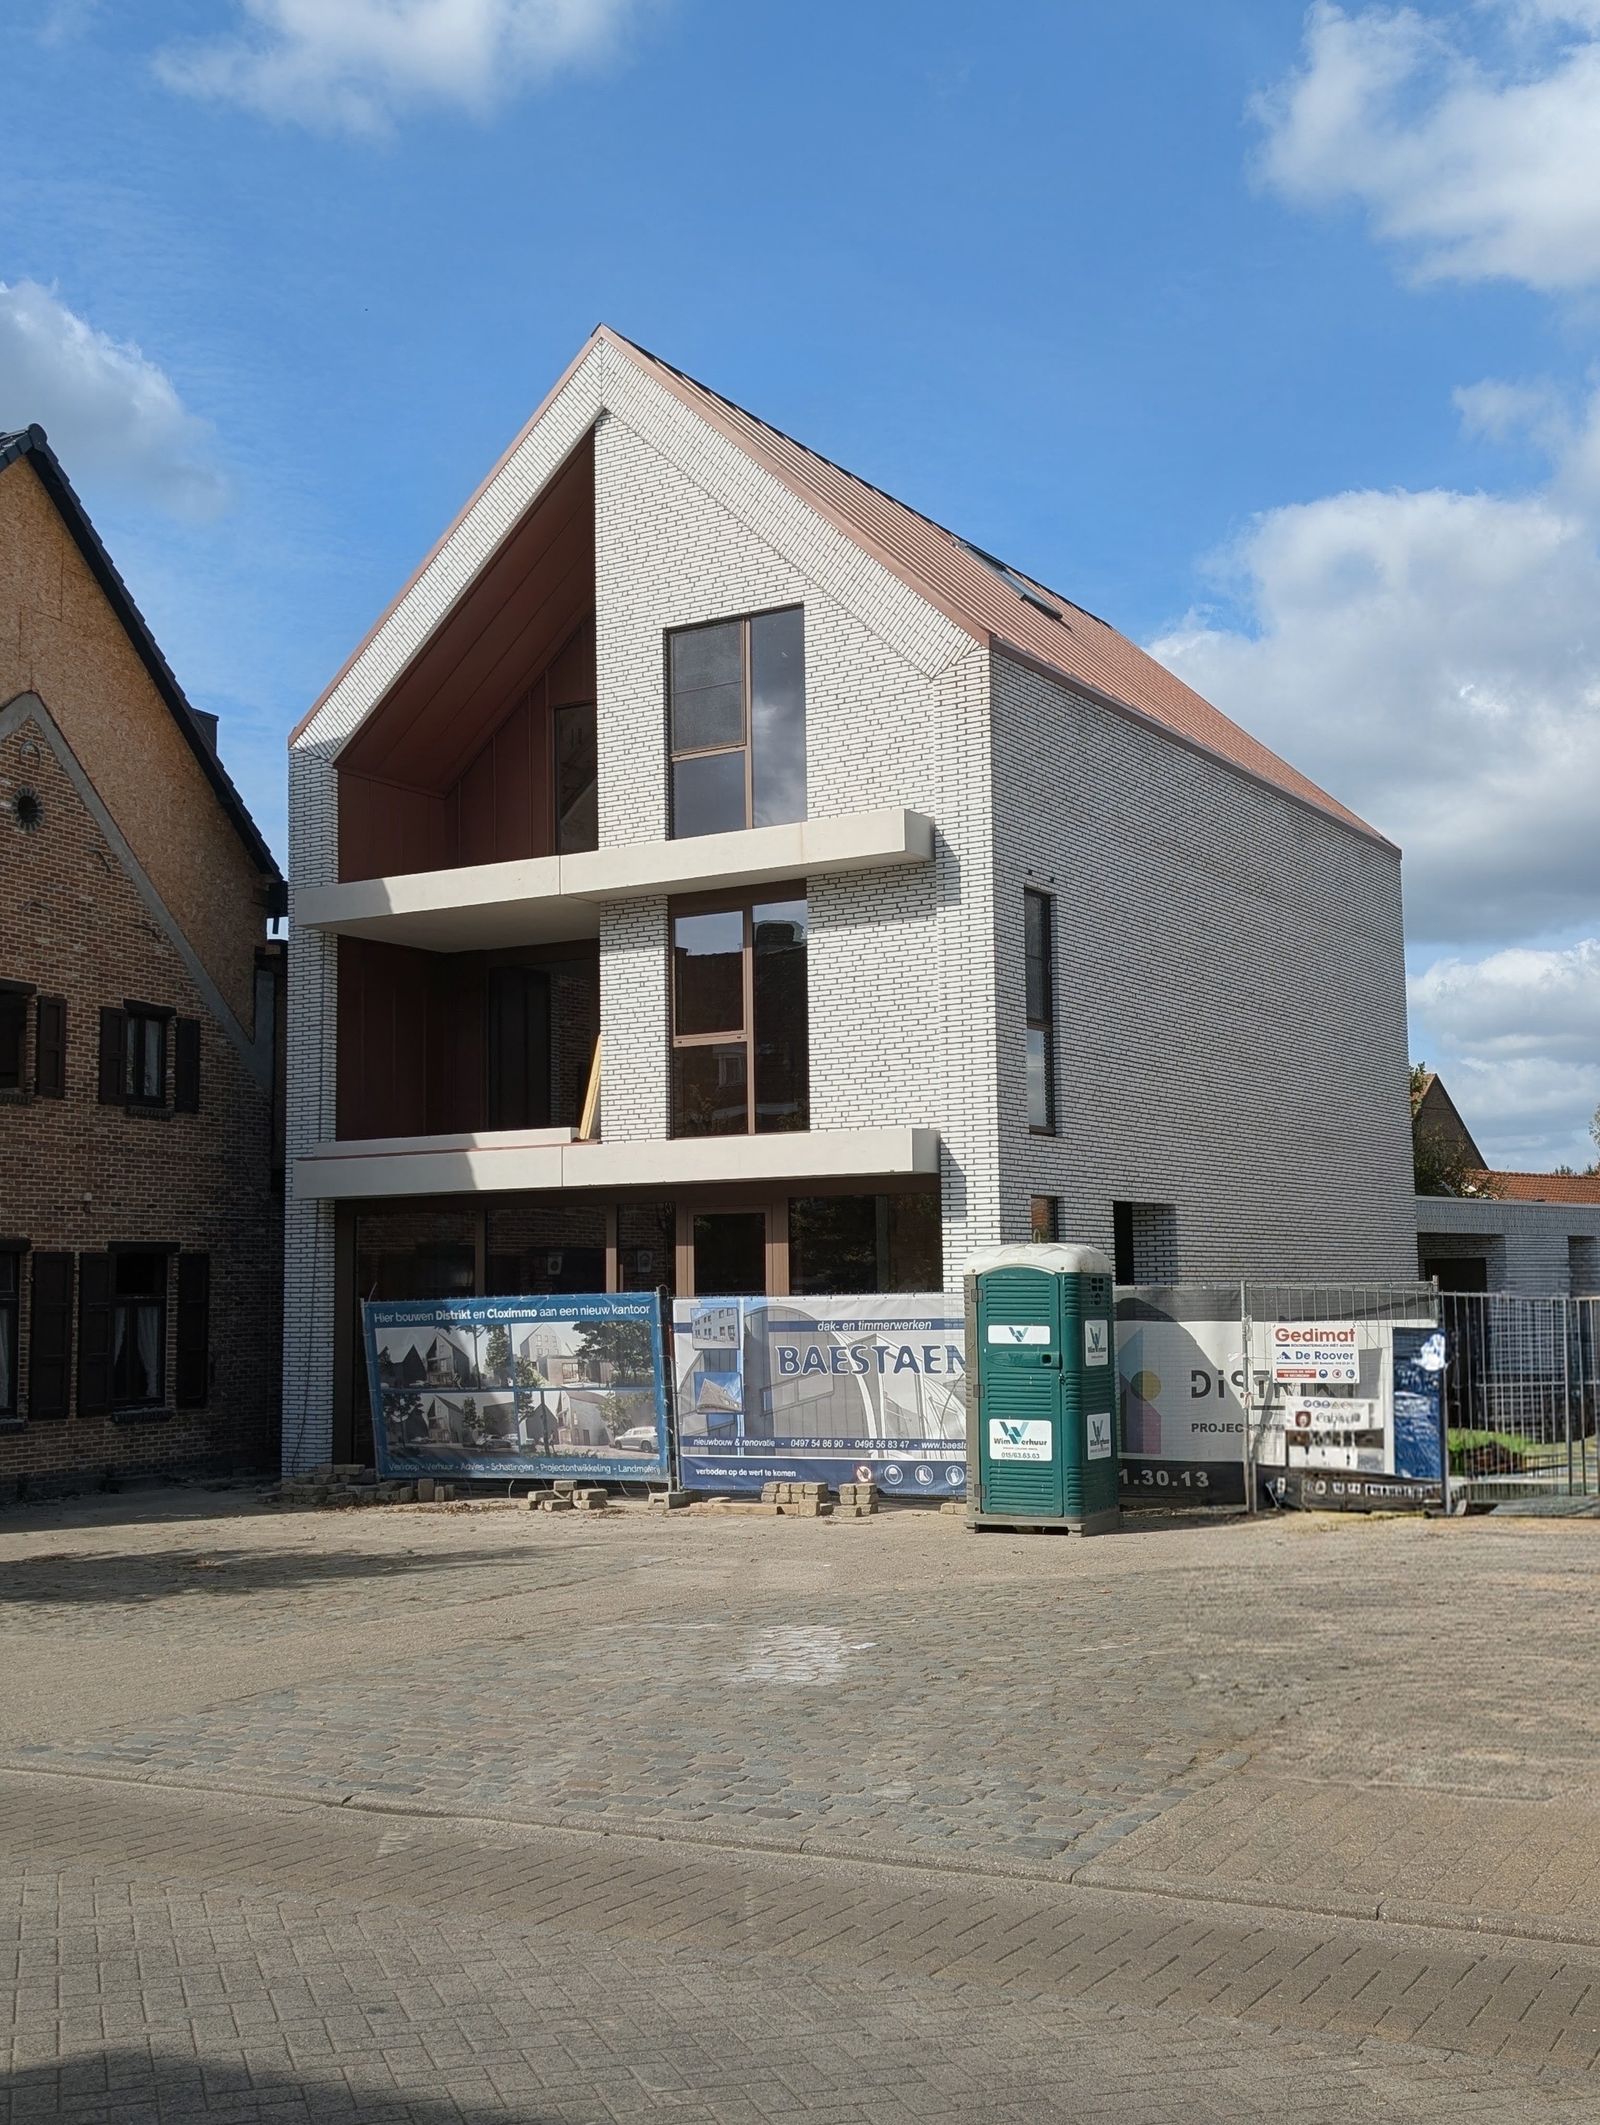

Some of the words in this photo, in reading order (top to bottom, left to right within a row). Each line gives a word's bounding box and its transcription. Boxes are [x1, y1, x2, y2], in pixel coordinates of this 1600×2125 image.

[374, 1313, 394, 1322] Hier
[395, 1312, 433, 1321] bouwen
[436, 1309, 471, 1320] Distrikt
[487, 1308, 537, 1318] Cloximmo
[540, 1308, 557, 1317] aan
[560, 1307, 578, 1316] een
[580, 1305, 610, 1316] nieuw
[612, 1304, 650, 1315] kantoor
[817, 1321, 839, 1331] dak-
[843, 1322, 855, 1331] en
[858, 1320, 932, 1331] timmerwerken
[1275, 1328, 1355, 1342] Gedimat
[1296, 1351, 1310, 1360] De
[1315, 1351, 1354, 1360] Roover
[694, 1438, 732, 1446] nieuwbouw
[742, 1439, 775, 1447] renovatie
[790, 1439, 809, 1447] 0497
[811, 1439, 820, 1447] 54
[834, 1440, 844, 1448] 90
[855, 1440, 874, 1448] 0496
[876, 1440, 886, 1448] 56
[888, 1440, 898, 1448] 83
[900, 1440, 910, 1448] 47
[540, 1464, 612, 1474] Projectontwikkeling
